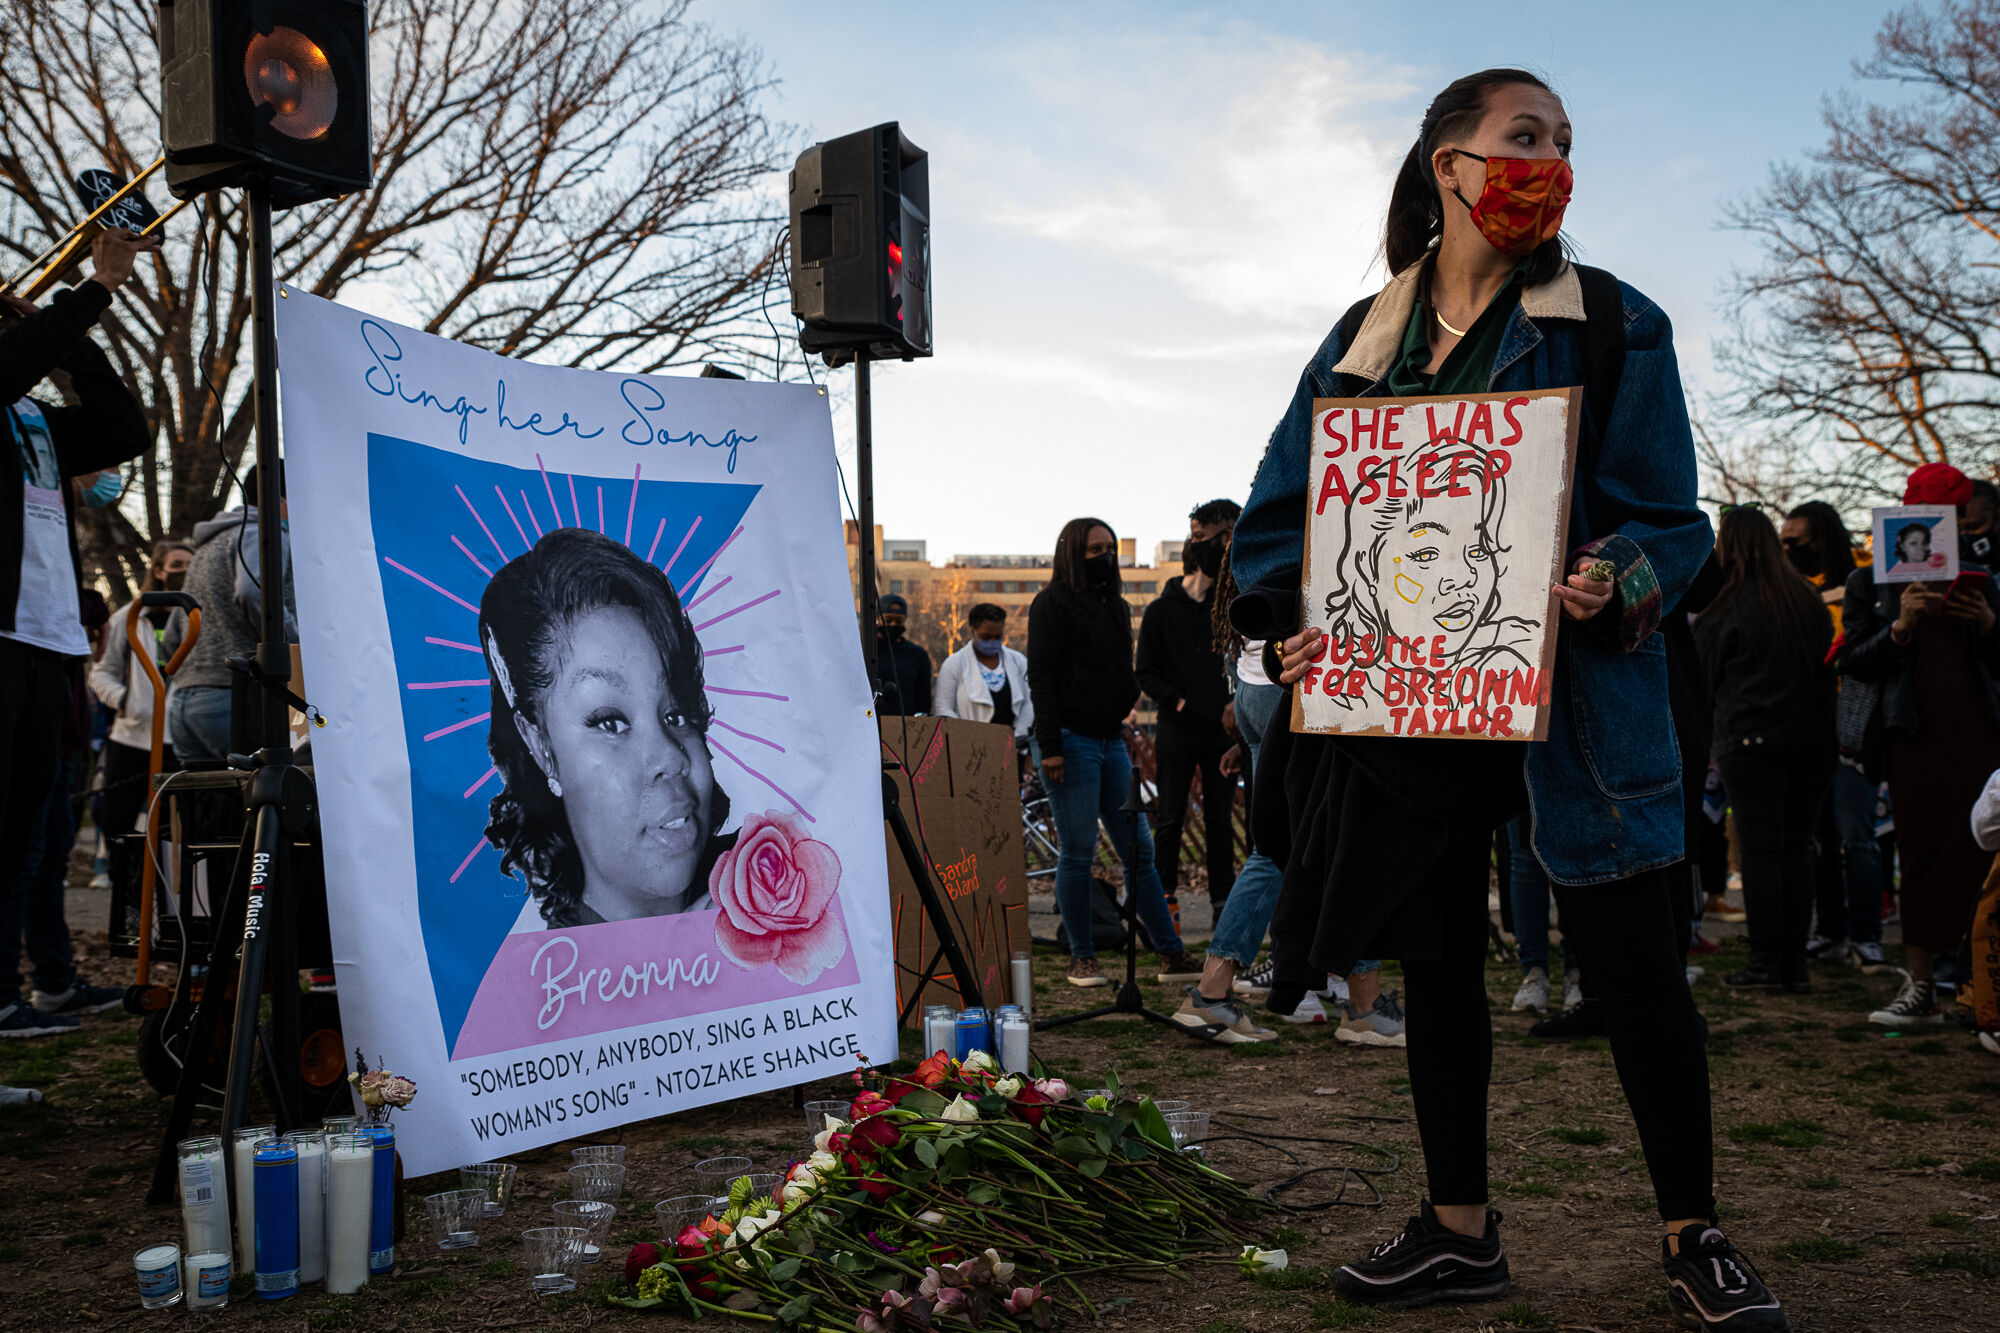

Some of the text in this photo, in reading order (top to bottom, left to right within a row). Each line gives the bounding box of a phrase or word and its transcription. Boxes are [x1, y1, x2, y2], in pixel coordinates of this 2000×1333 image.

[361, 319, 758, 474] Sing her Song
[1322, 396, 1530, 459] SHE WAS
[1315, 449, 1512, 516] ASLEEP
[1303, 666, 1551, 708] FOR BREONNA
[1389, 704, 1515, 738] TAYLOR
[935, 847, 978, 884] Sandra
[945, 876, 980, 901] Bland
[244, 895, 264, 939] Music
[530, 935, 721, 1031] Breonna
[461, 997, 859, 1097] "SOMEBODY, ANYBODY, SING A BLACK
[470, 1098, 567, 1143] WOMAN'S
[573, 1081, 637, 1118] SONG"
[656, 1056, 758, 1099] NTOZAKE
[763, 1033, 862, 1074] SHANGE
